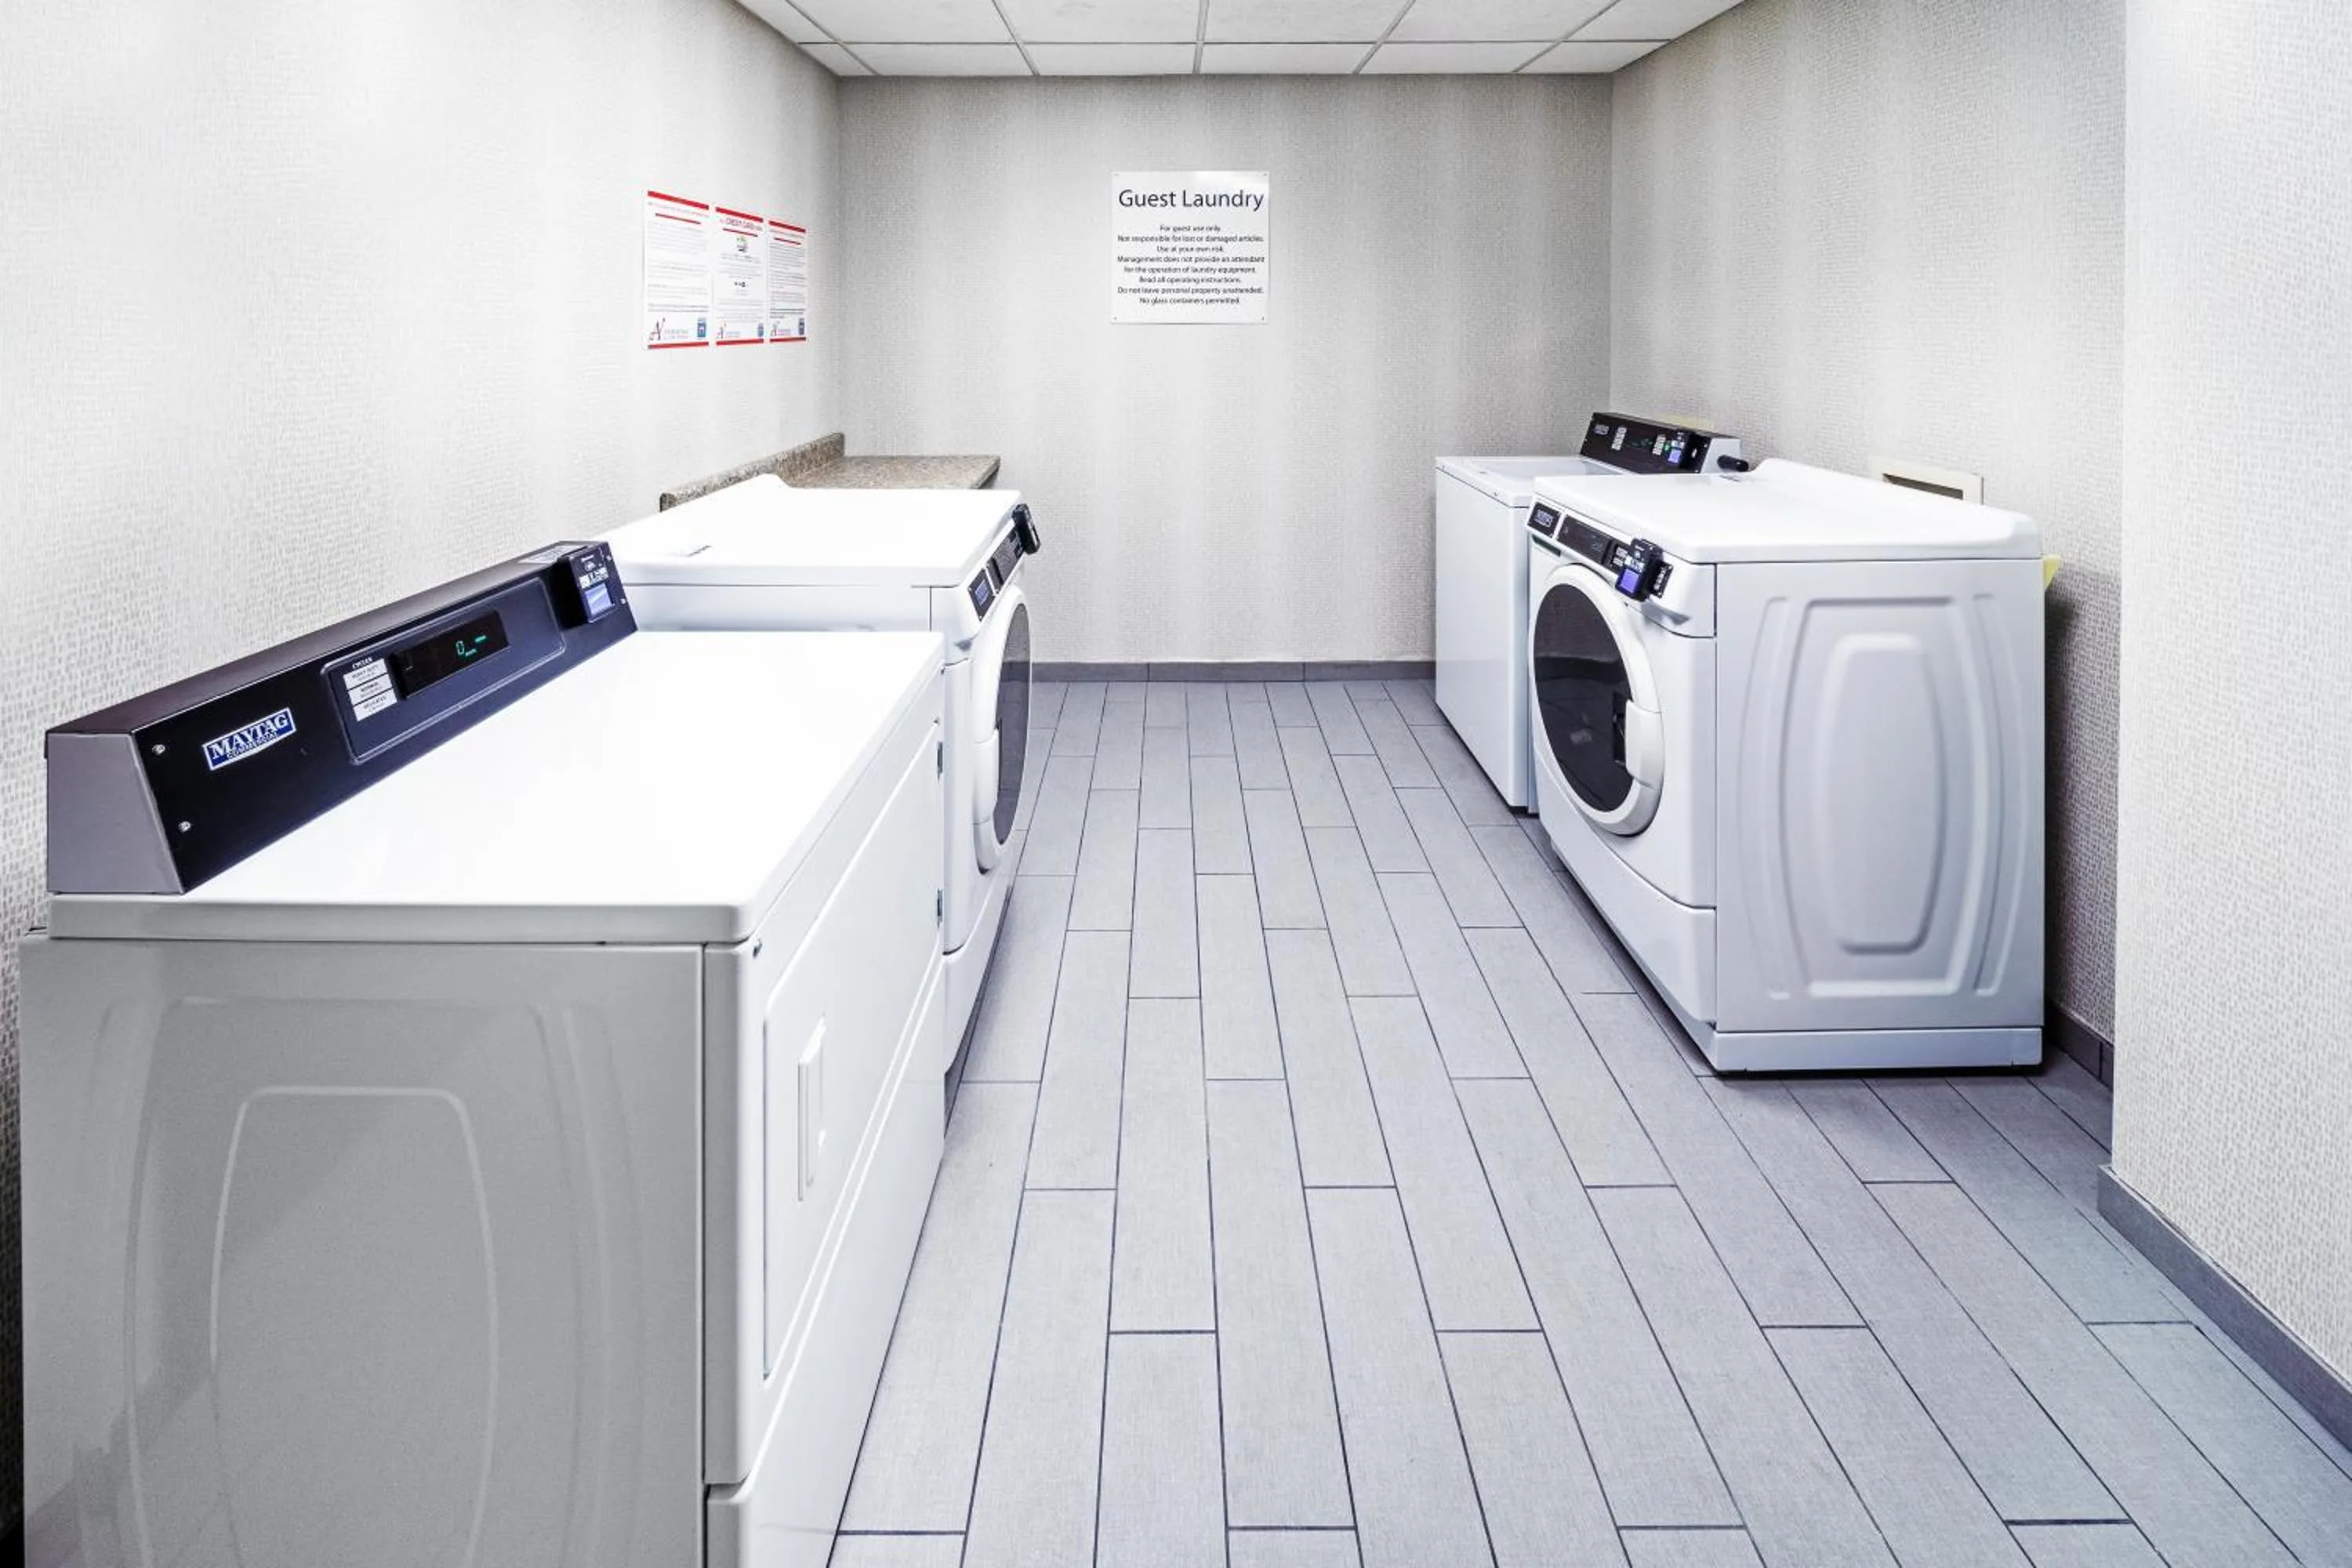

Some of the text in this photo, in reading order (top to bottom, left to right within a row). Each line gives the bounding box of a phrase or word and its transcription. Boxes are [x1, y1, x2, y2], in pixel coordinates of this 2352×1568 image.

[1119, 189, 1264, 212] Guest Laundry
[1116, 256, 1162, 264] Management
[1194, 256, 1220, 264] provide
[1191, 267, 1216, 275] laundry
[1150, 297, 1167, 306] glass
[208, 713, 289, 760] MAYTAG
